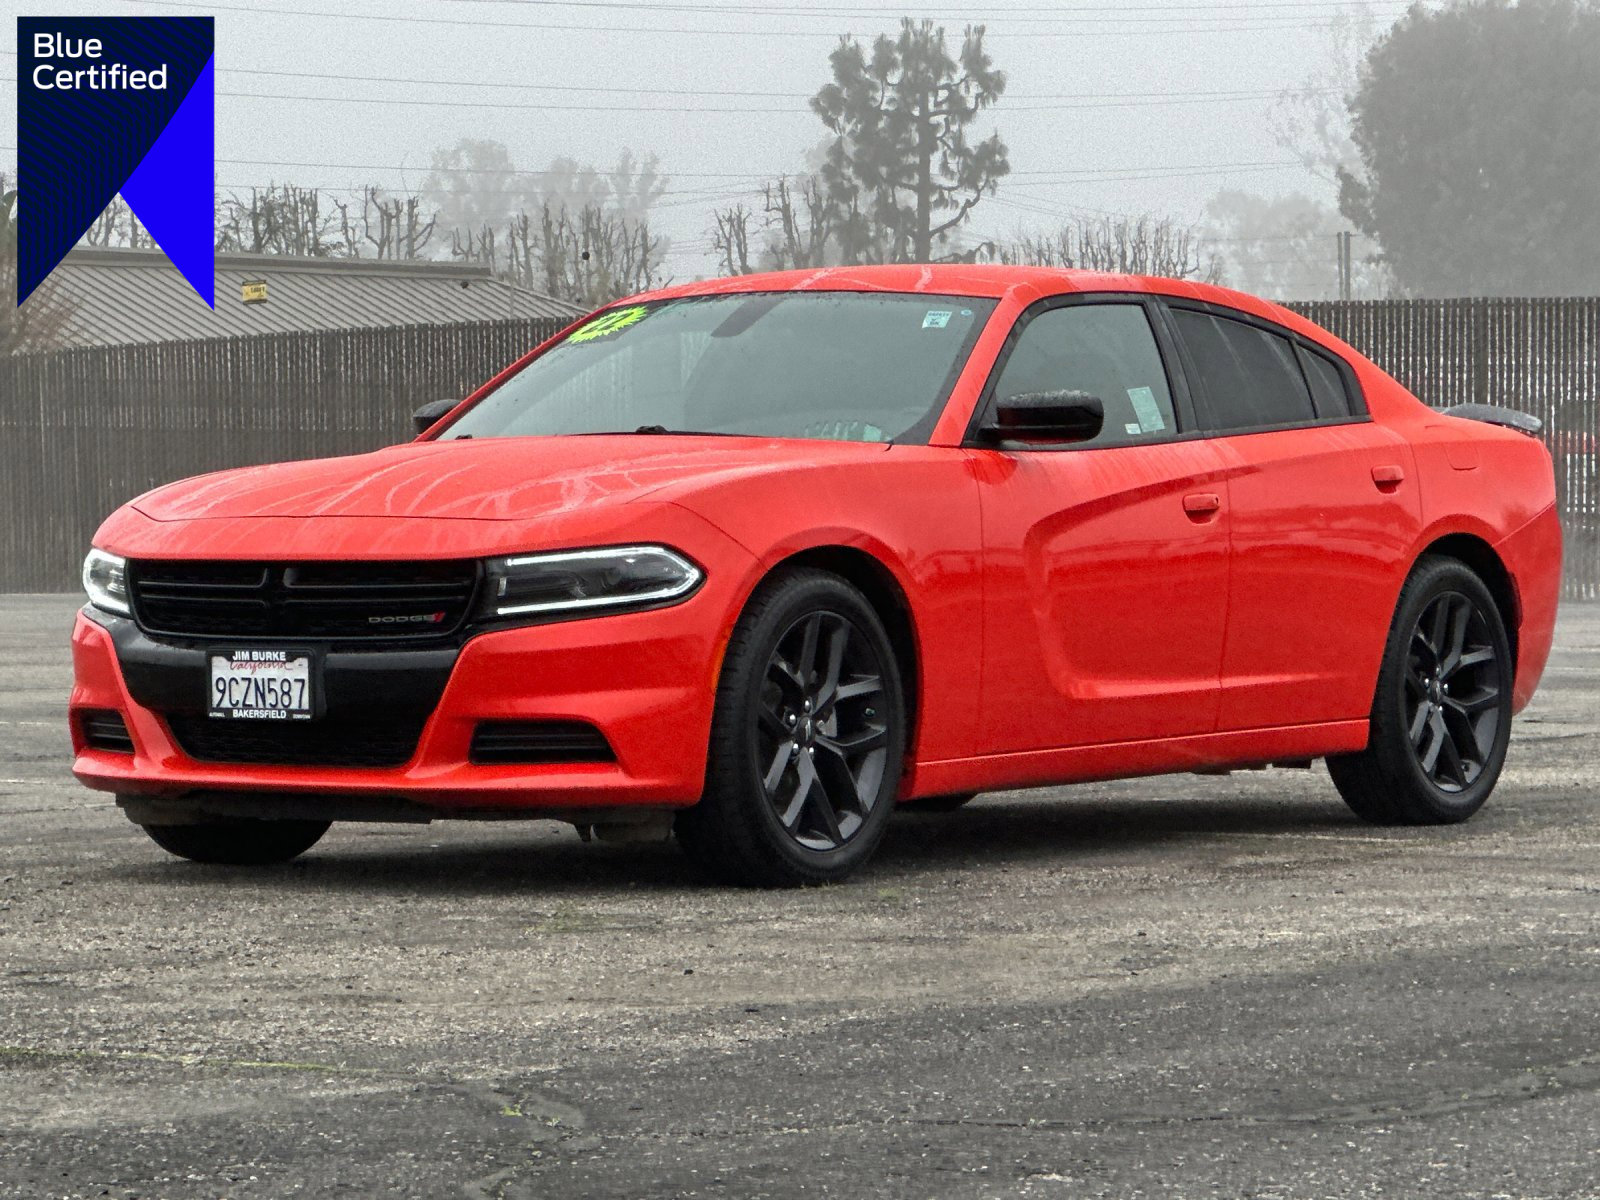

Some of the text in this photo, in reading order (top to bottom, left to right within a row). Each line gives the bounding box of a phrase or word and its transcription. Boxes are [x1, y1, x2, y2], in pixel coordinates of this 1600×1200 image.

[368, 614, 435, 624] DODGE
[232, 651, 287, 661] JIM BURKE
[215, 677, 306, 709] 9CZN587
[232, 709, 287, 719] BAKERSFIELD
